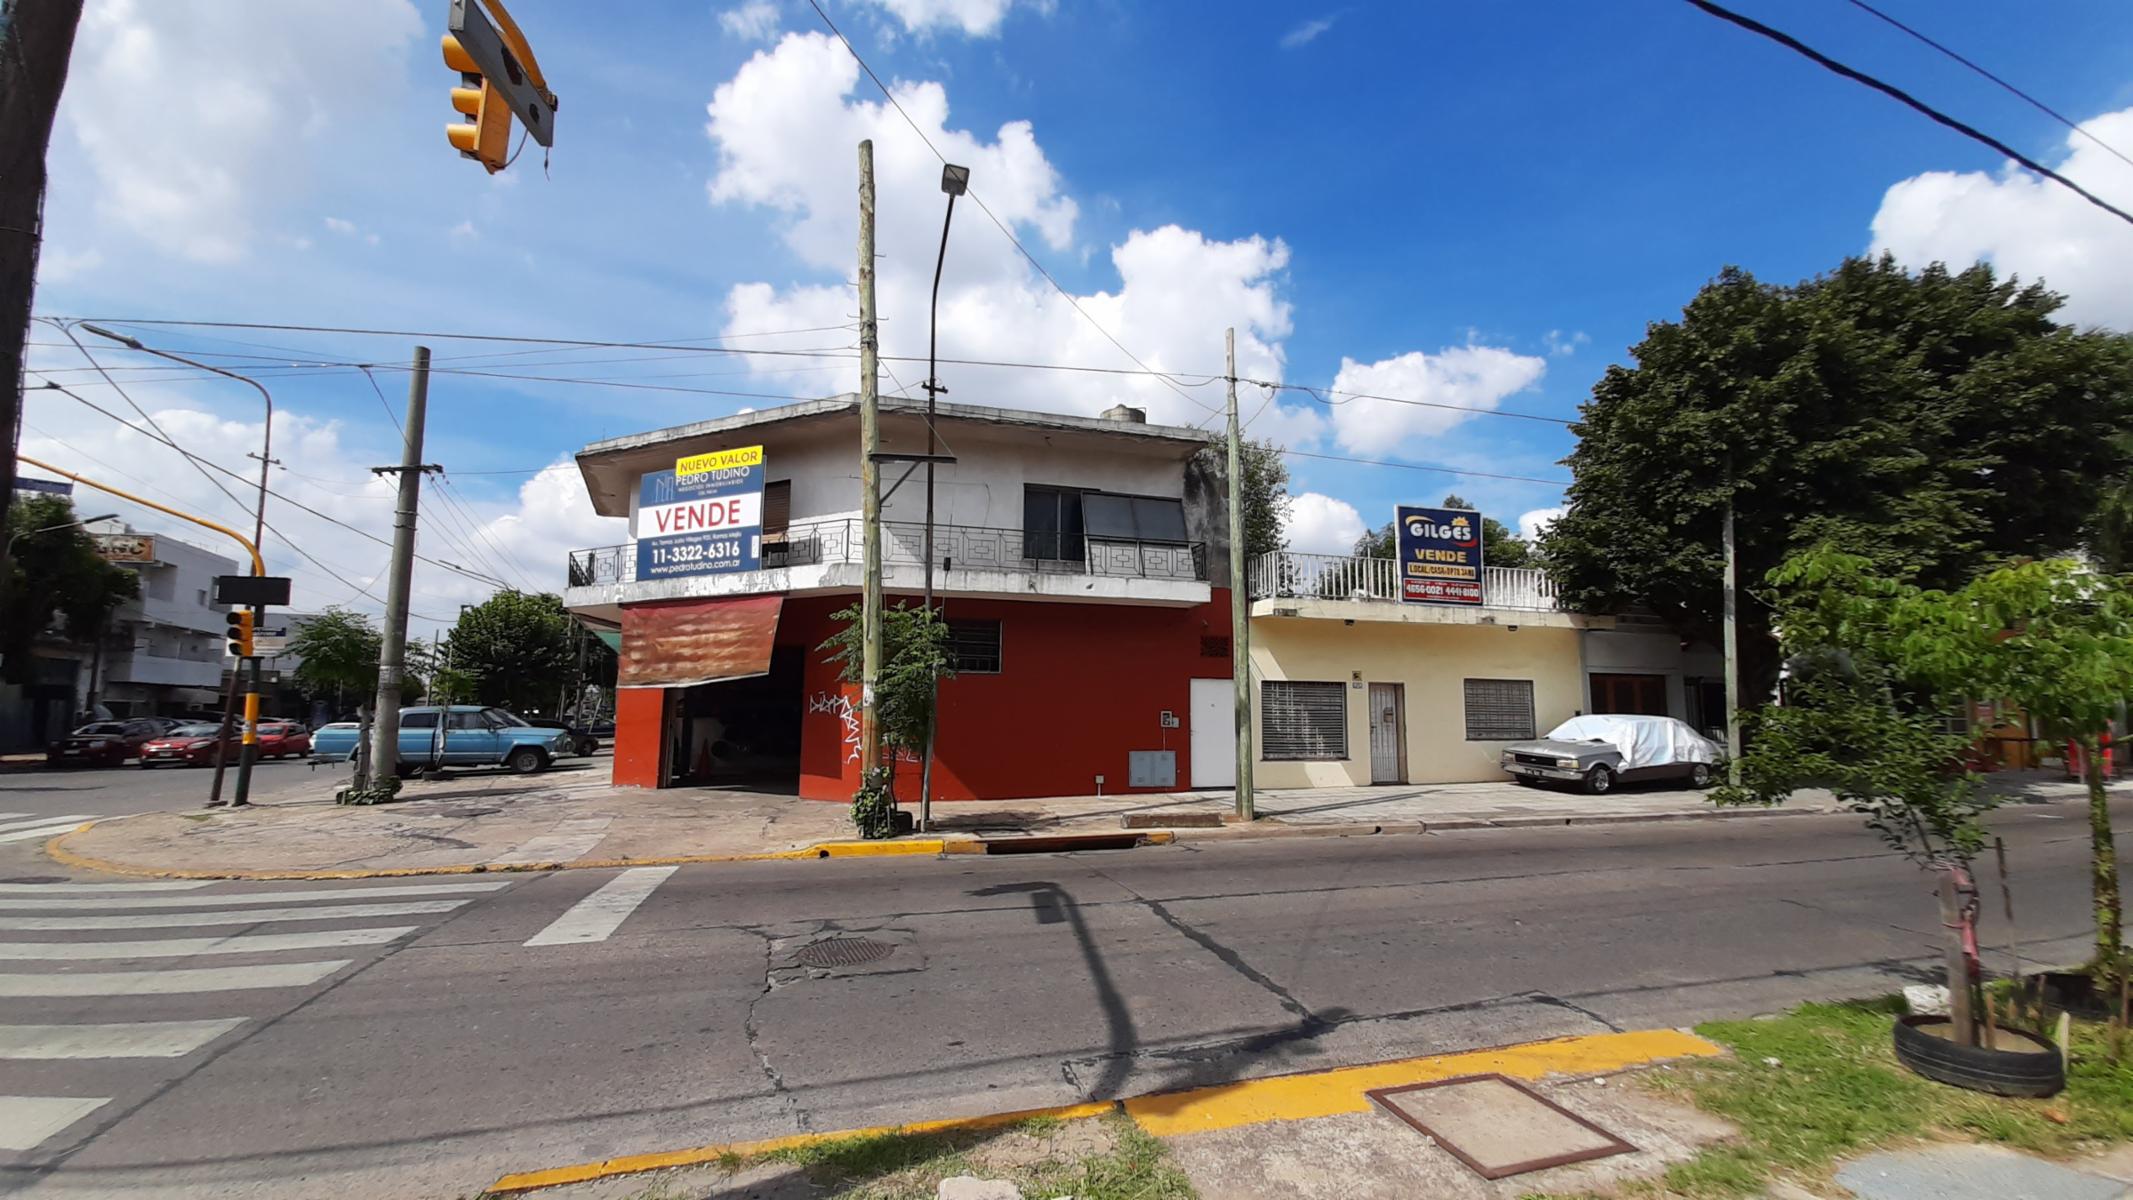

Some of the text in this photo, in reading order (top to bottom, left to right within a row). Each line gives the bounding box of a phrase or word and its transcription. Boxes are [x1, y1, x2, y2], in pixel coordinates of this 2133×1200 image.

[680, 450, 758, 473] NUEVO VALOR
[675, 466, 750, 486] PEDRO TUDINO
[655, 499, 741, 533] VENDE
[1410, 522, 1472, 540] GILGES
[652, 541, 740, 564] 11-3322-6316
[1415, 548, 1467, 563] VENDE
[650, 560, 740, 574] www.pedrotudino.com.ar
